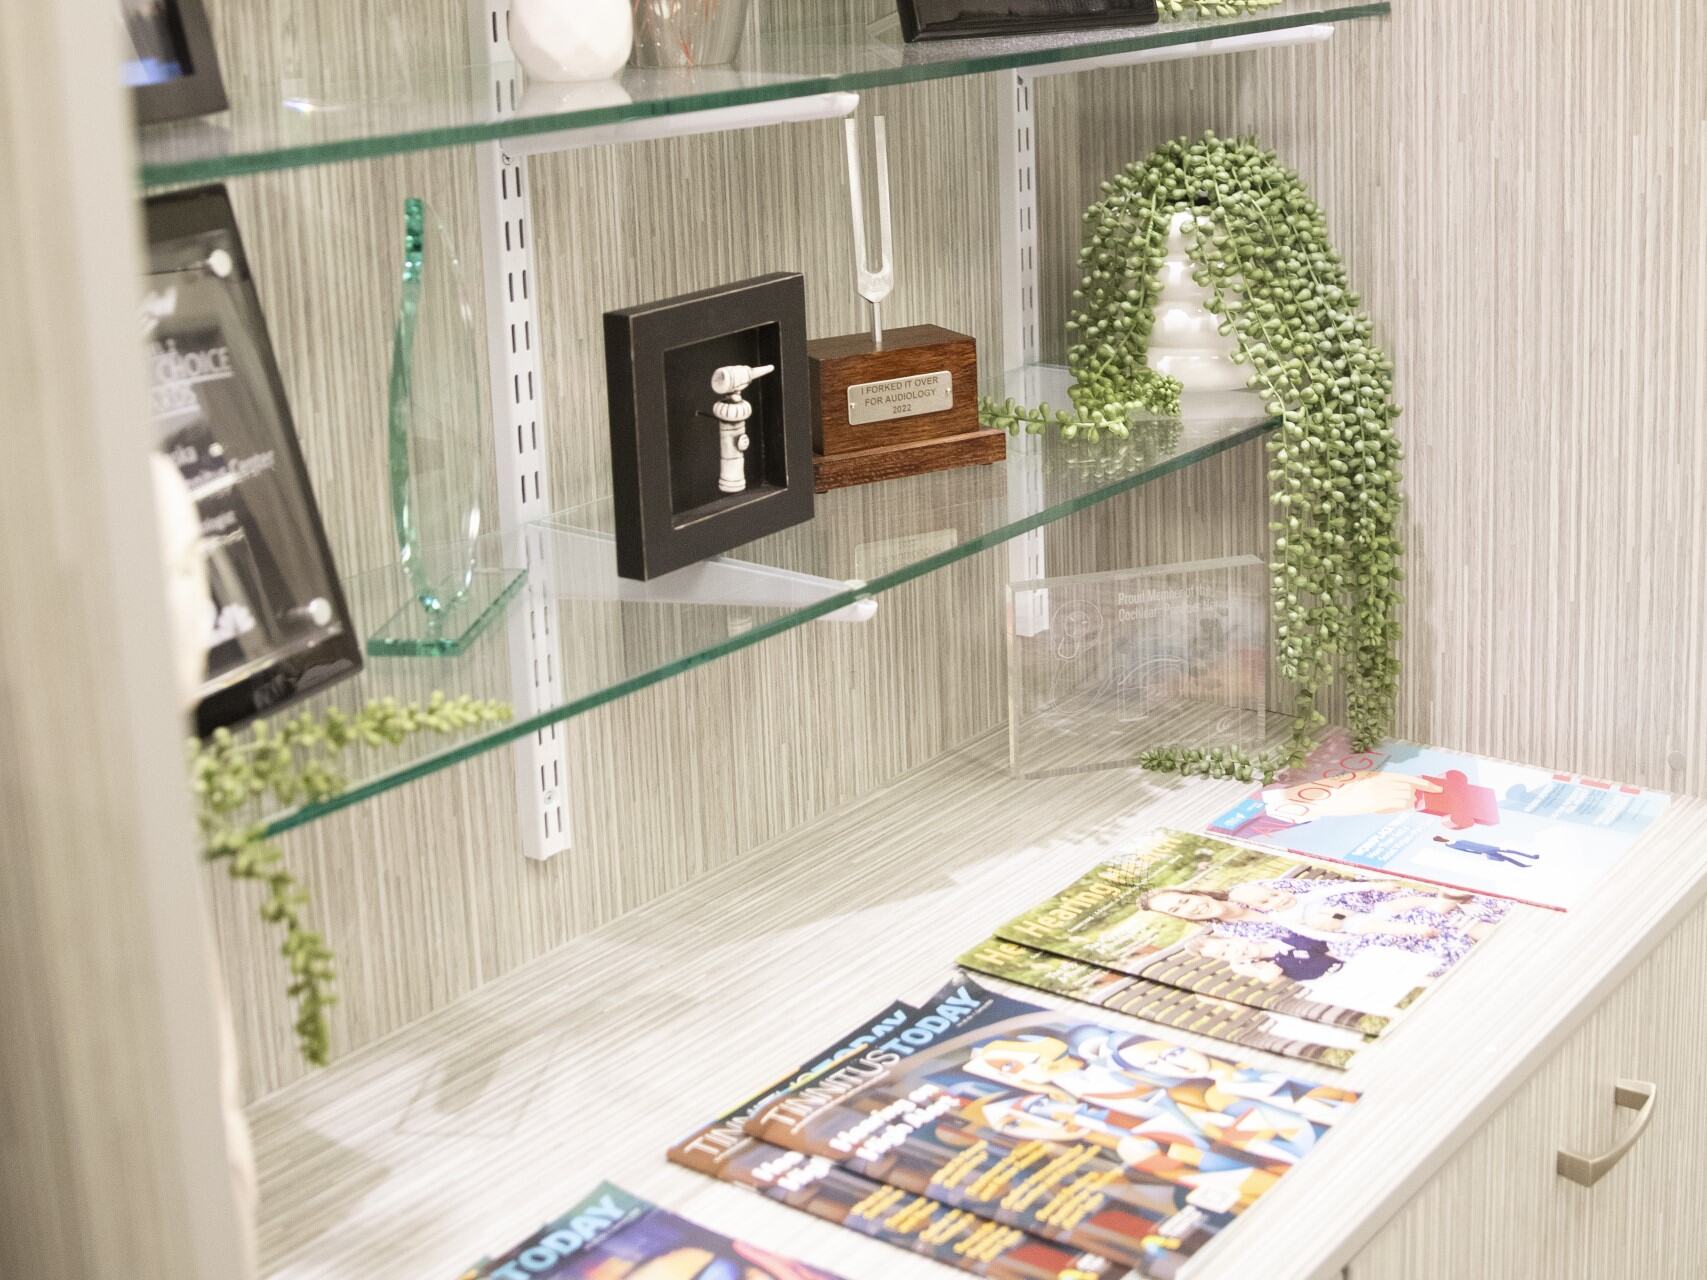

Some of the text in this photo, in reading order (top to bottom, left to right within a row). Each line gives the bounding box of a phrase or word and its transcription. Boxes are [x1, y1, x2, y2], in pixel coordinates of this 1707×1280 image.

[865, 388, 936, 407] FOR AUDIOLOGY
[866, 381, 903, 395] FORKED
[904, 380, 912, 389] IT
[914, 376, 939, 387] OVER
[893, 403, 912, 415] 2022
[1013, 882, 1122, 938] Hearing
[760, 985, 981, 1127] TINNITUS TODAY
[489, 1194, 626, 1280] TODAY
